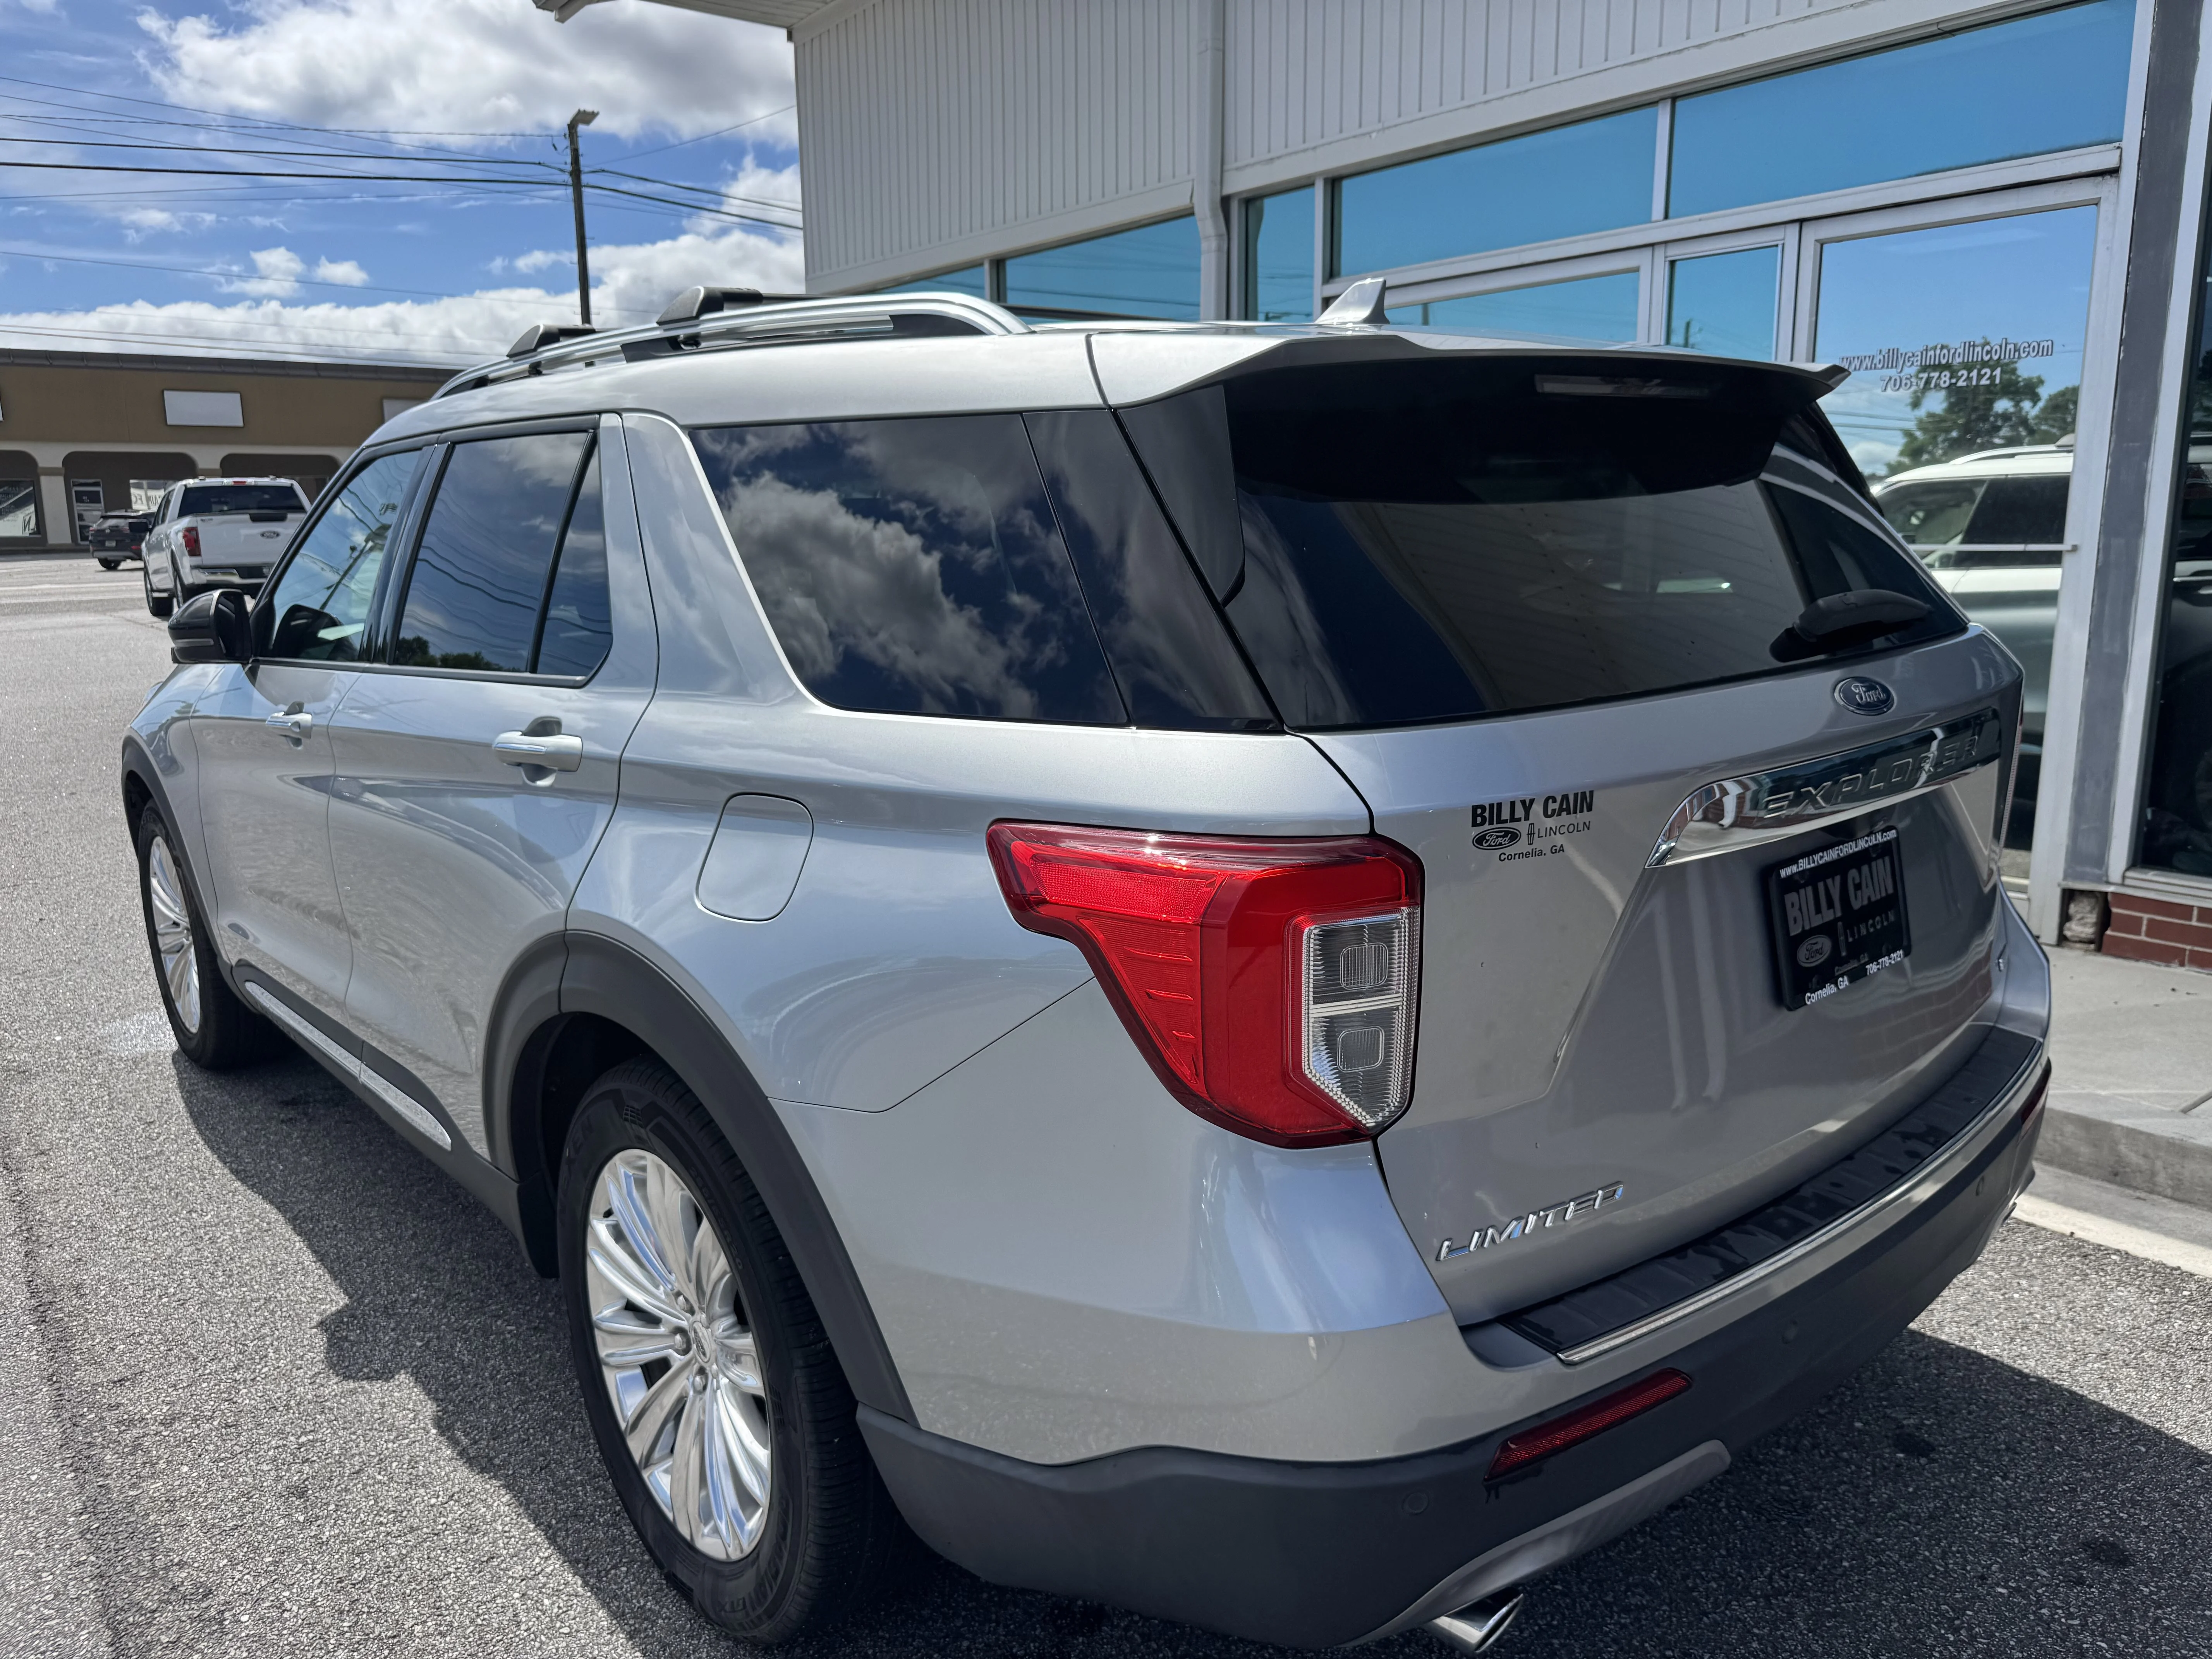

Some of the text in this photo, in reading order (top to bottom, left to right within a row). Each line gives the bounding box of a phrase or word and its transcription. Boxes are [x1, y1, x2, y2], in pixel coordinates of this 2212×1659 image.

[1839, 338, 2053, 373] www.billycainfordlincoln.com
[1881, 367, 2001, 392] 706-778-2121
[1851, 683, 1886, 705] Ford
[1764, 735, 1979, 818] EXPLORER
[1471, 790, 1594, 827] BILLY CAIN
[1482, 832, 1511, 847] Ford
[1537, 821, 1590, 838] LINCOLN
[1550, 843, 1565, 854] GA
[1779, 829, 1896, 879] www.BILLYCAINFORDLINCOLN.com
[1784, 855, 1894, 936] BILLY CAIN
[1847, 910, 1895, 942] LINCOLN
[1866, 949, 1904, 975] 706-778-2121
[1838, 975, 1849, 989] GA
[1436, 1181, 1624, 1261] LIMITED
